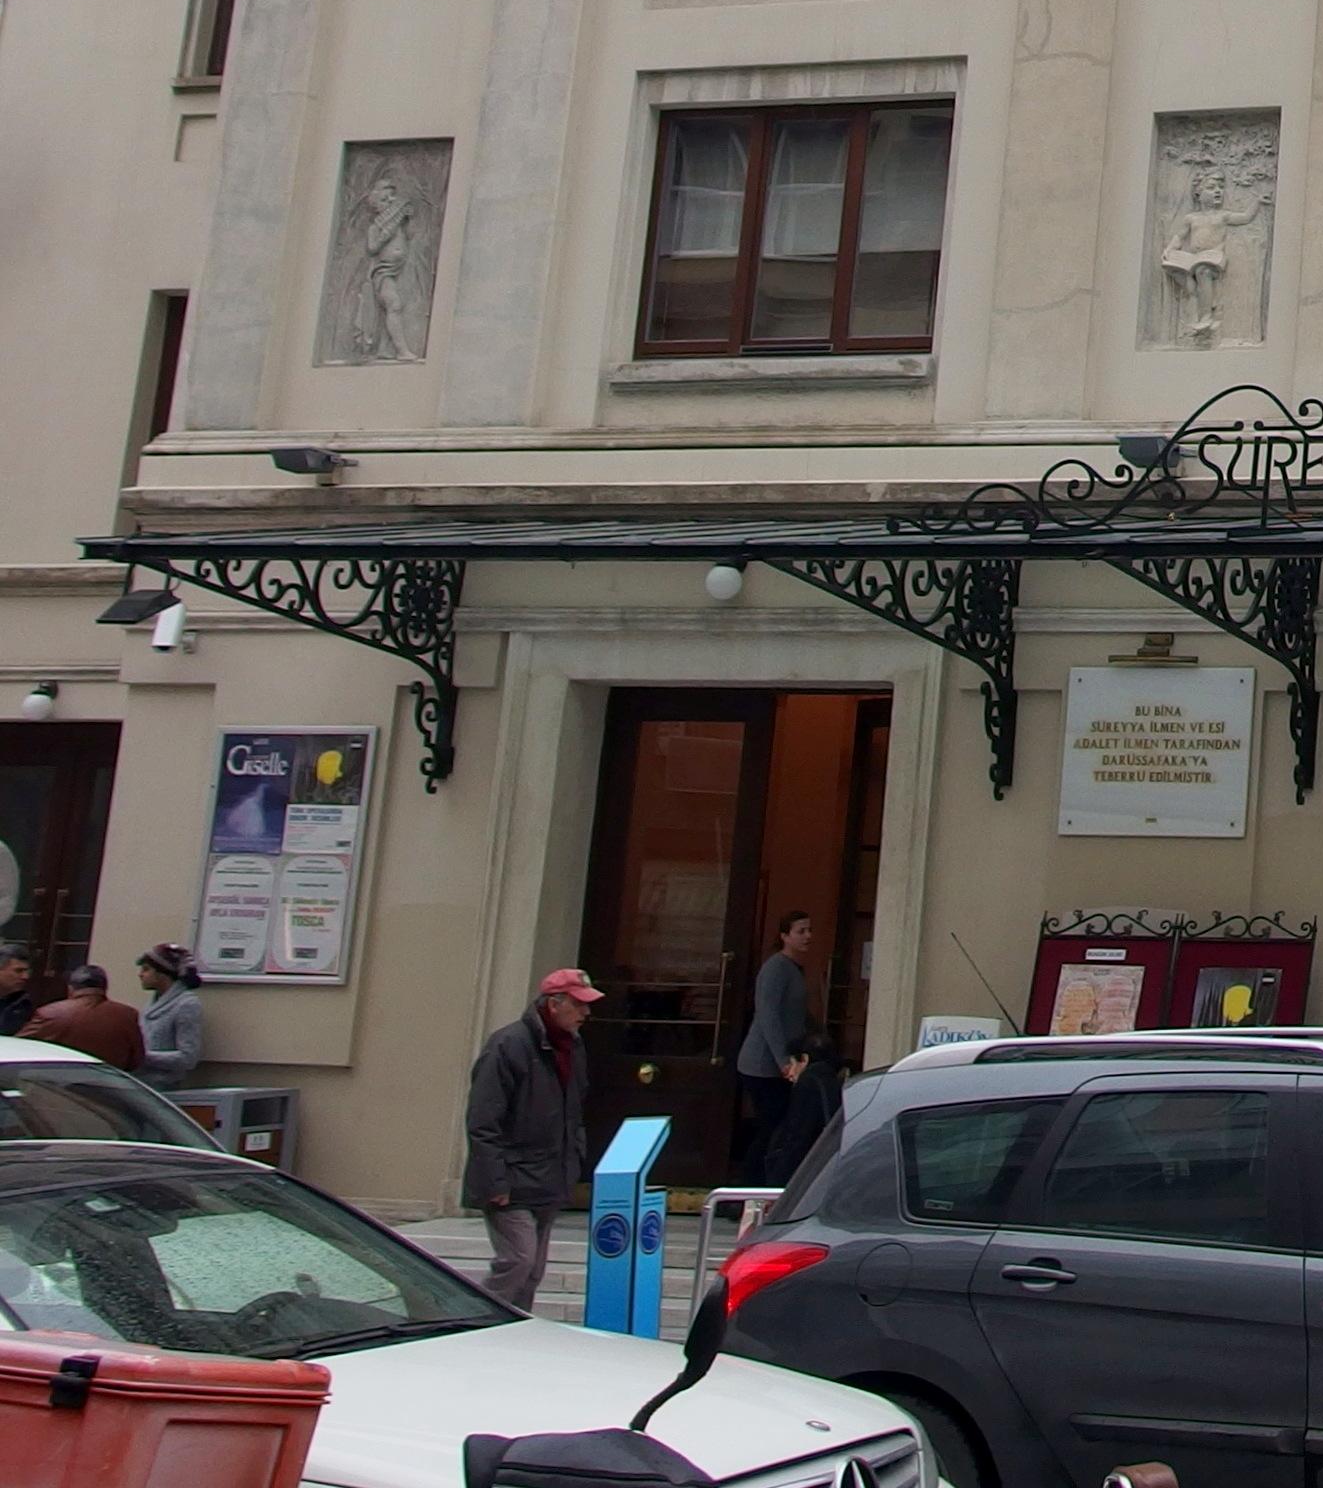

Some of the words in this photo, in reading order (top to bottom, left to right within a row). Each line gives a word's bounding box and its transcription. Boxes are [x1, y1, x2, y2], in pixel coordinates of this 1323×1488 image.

[1135, 706, 1151, 717] BU
[1190, 722, 1204, 733] VE
[1073, 737, 1120, 750] ADALET
[1163, 738, 1241, 751] TARAFINDAN
